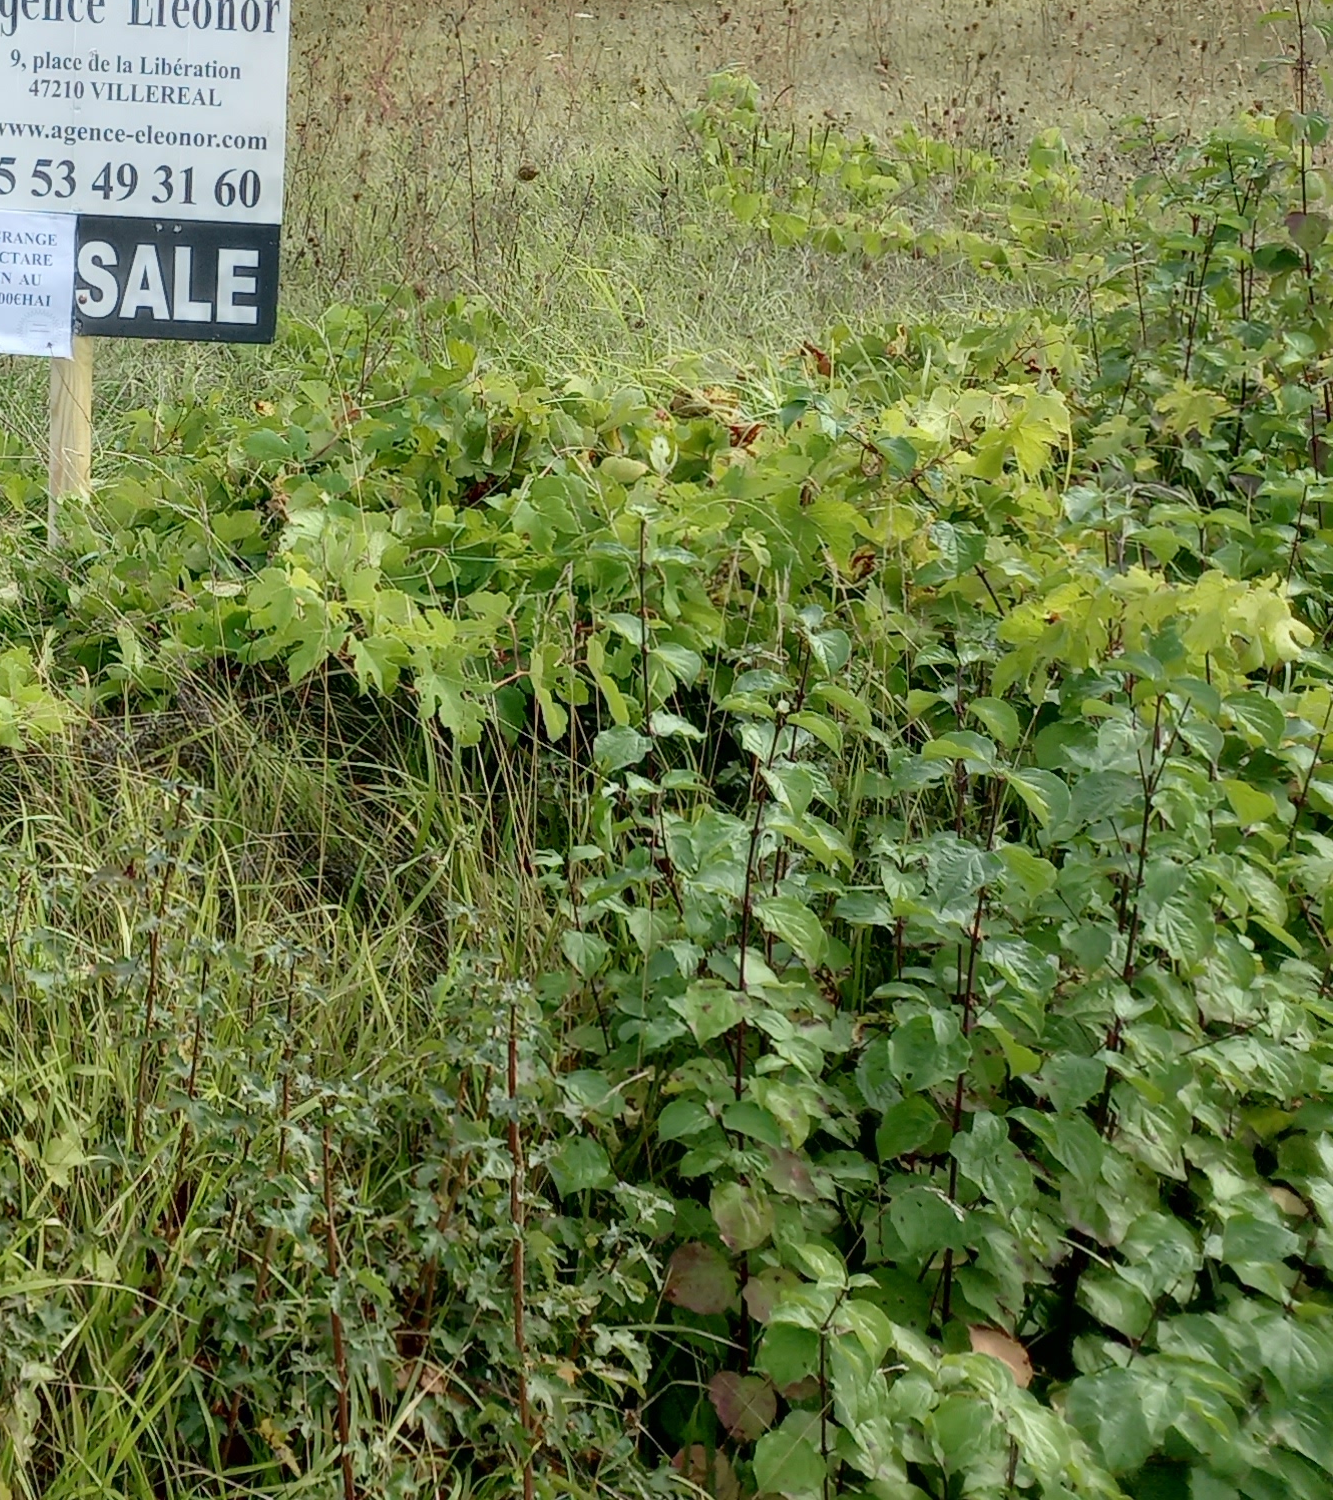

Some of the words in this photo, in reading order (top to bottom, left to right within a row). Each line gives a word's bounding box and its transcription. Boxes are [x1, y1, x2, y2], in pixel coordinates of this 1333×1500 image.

[10, 49, 27, 70] 9,
[33, 51, 82, 74] place
[88, 53, 110, 72] de
[116, 55, 132, 73] la
[140, 56, 241, 80] Libération
[29, 79, 84, 99] 47210
[90, 81, 222, 107] VILLEREAL
[31, 158, 77, 198] 53
[91, 161, 138, 202] 49
[151, 164, 197, 205] 31
[214, 168, 261, 208] 60
[19, 274, 41, 286] AU
[76, 240, 259, 325] SALE
